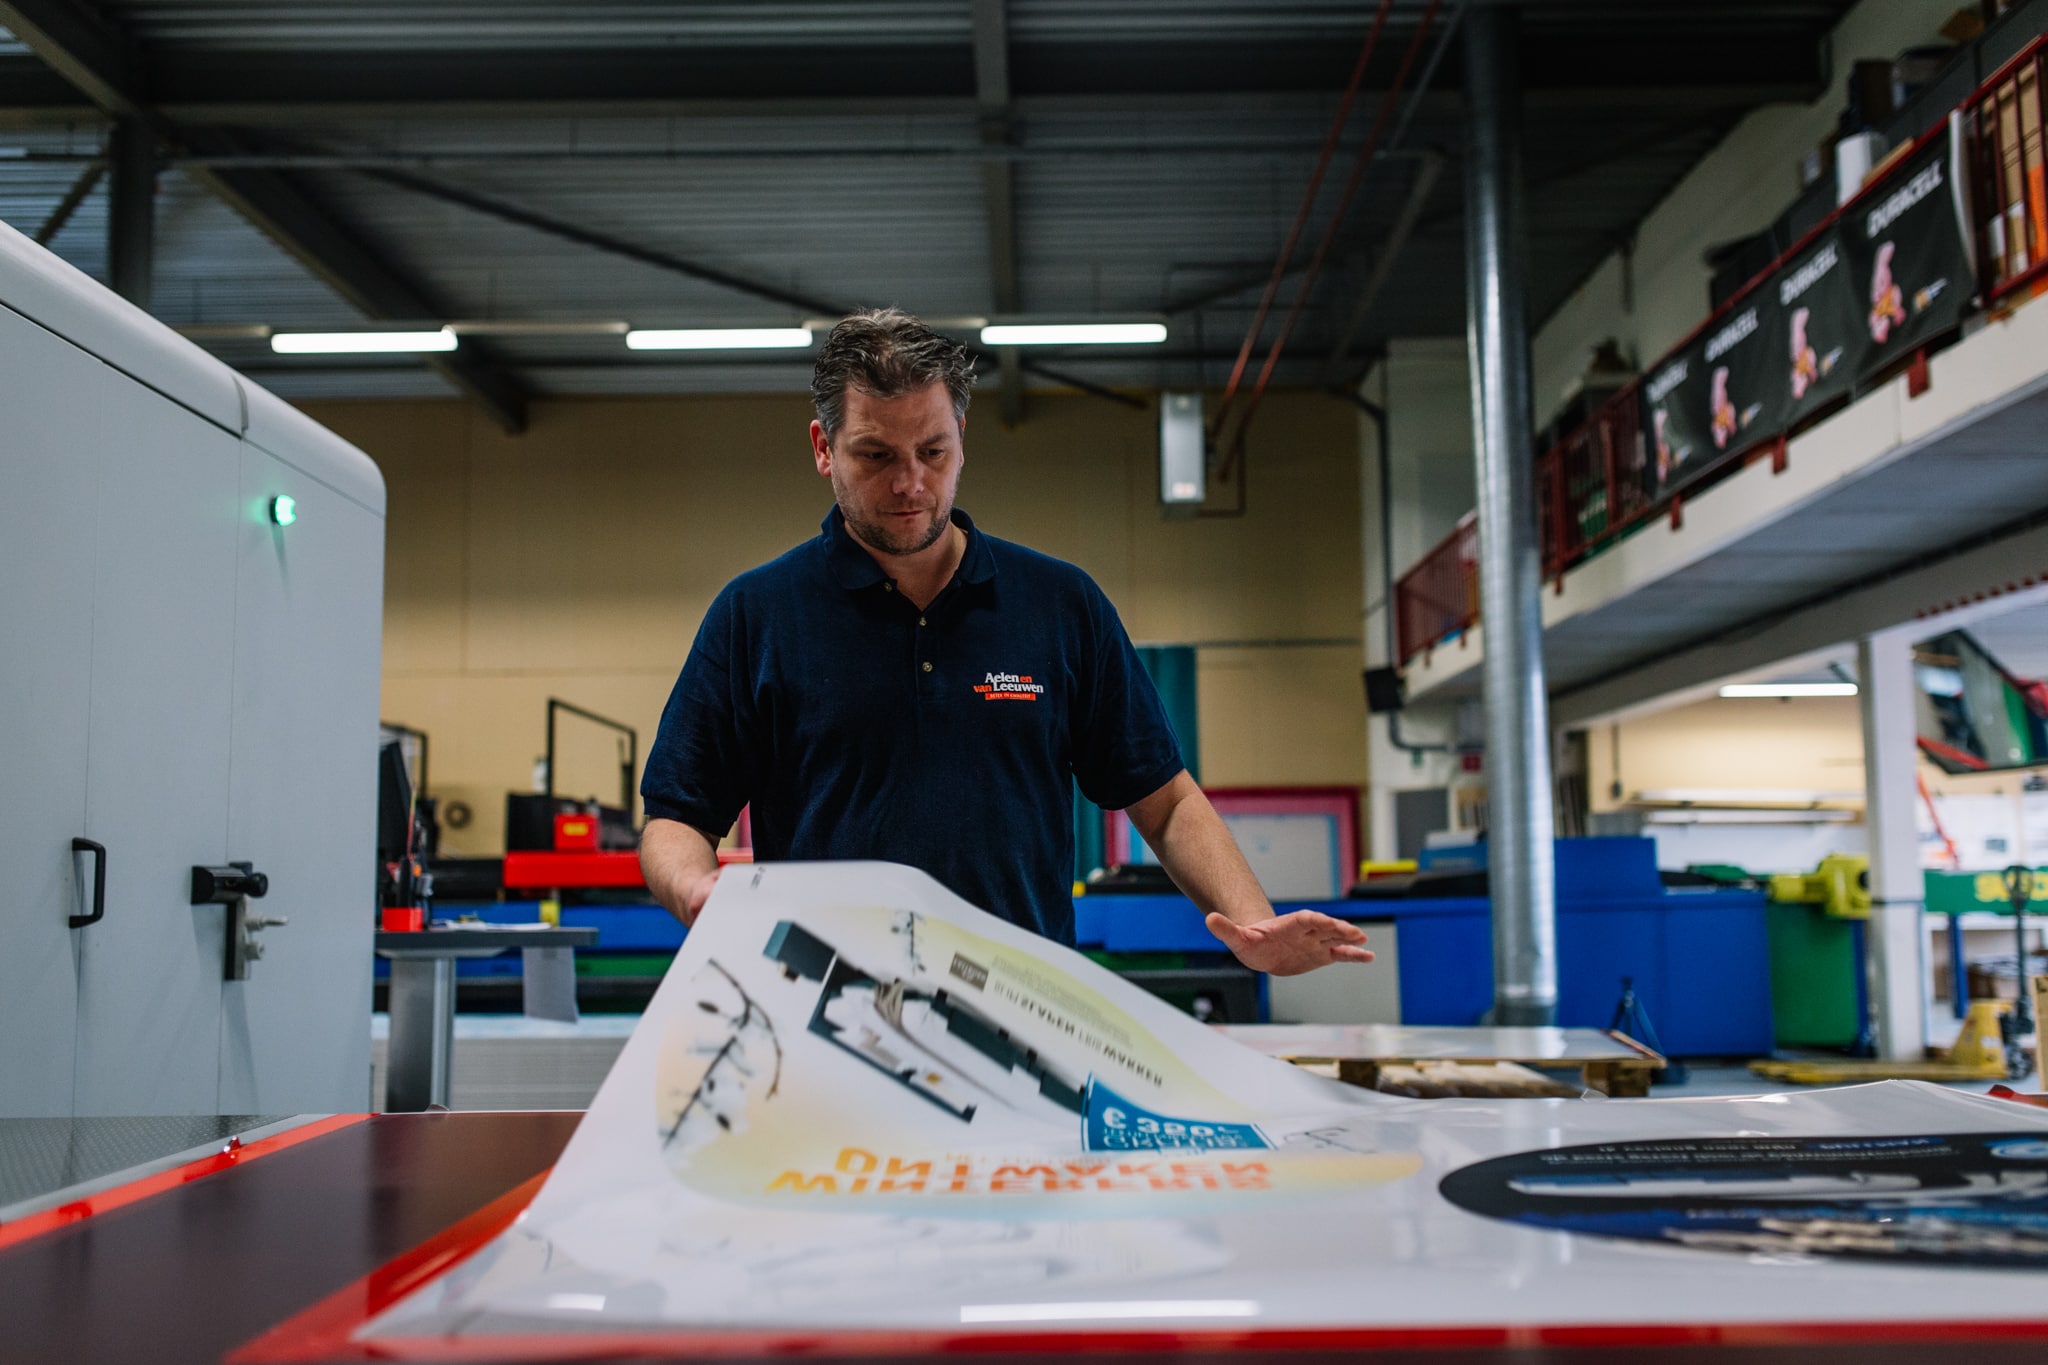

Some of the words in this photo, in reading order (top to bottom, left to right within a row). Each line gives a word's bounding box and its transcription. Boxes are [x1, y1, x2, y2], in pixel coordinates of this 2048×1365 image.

[1867, 157, 1945, 240] DURACELL
[1779, 242, 1839, 306] DURACELL
[973, 684, 992, 693] van
[993, 682, 1044, 693] Leeuwen
[985, 672, 1019, 683] Aelen
[1020, 675, 1033, 683] en
